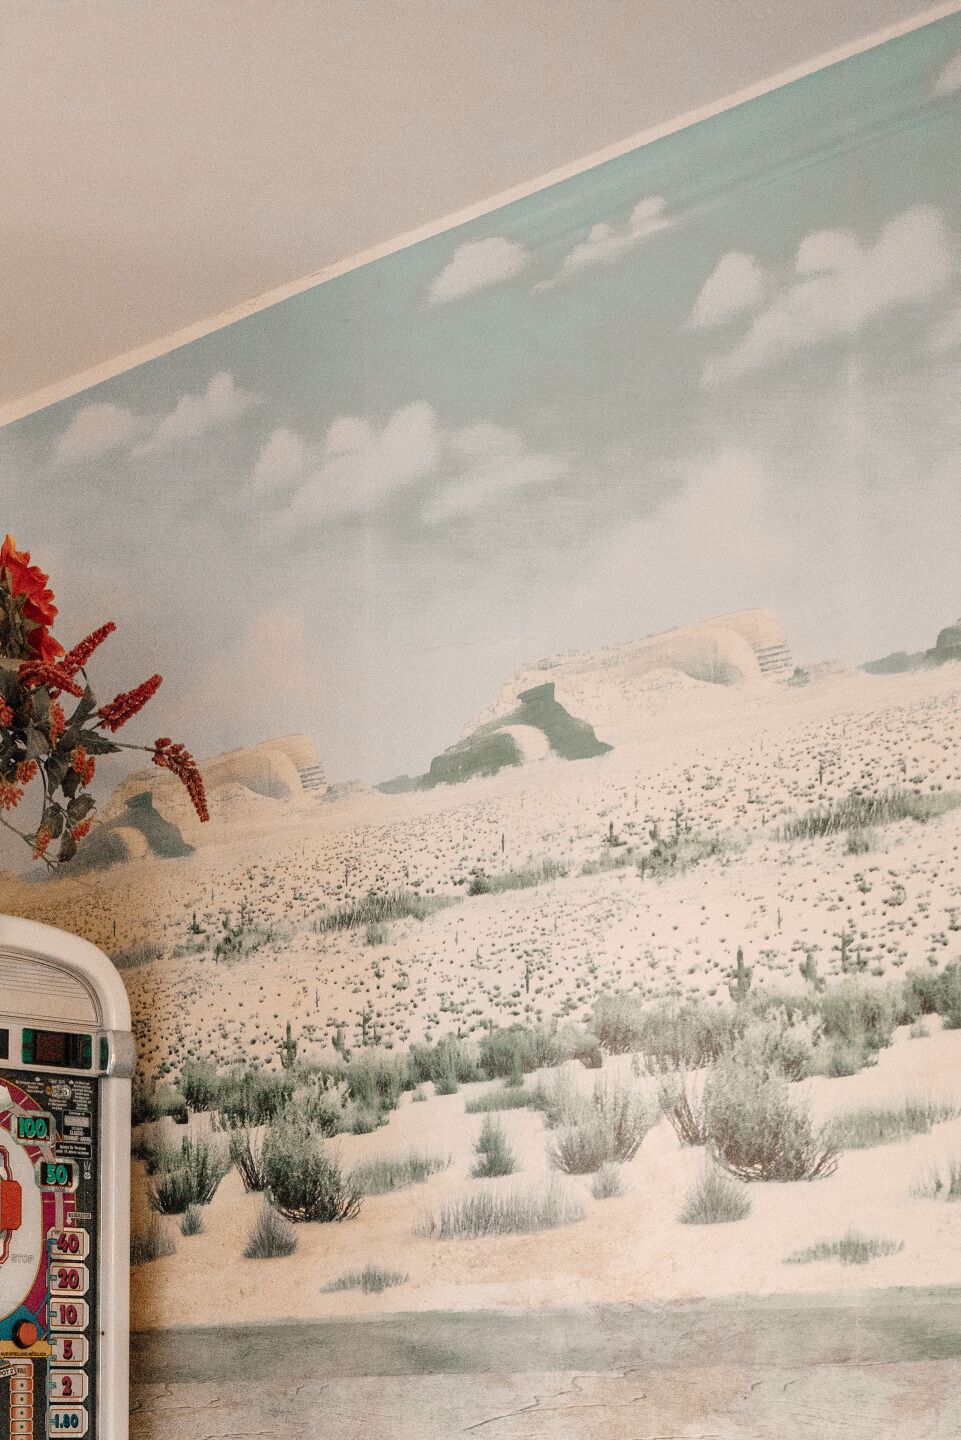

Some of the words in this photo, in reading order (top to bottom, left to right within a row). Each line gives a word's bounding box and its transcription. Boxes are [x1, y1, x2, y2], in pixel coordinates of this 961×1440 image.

[19, 1116, 48, 1138] 100
[46, 1163, 68, 1184] 50
[57, 1233, 80, 1254] 40
[11, 1253, 35, 1265] STOP
[58, 1268, 80, 1289] 20
[59, 1304, 78, 1325] 10
[62, 1339, 73, 1360] 5
[61, 1375, 72, 1396] 2
